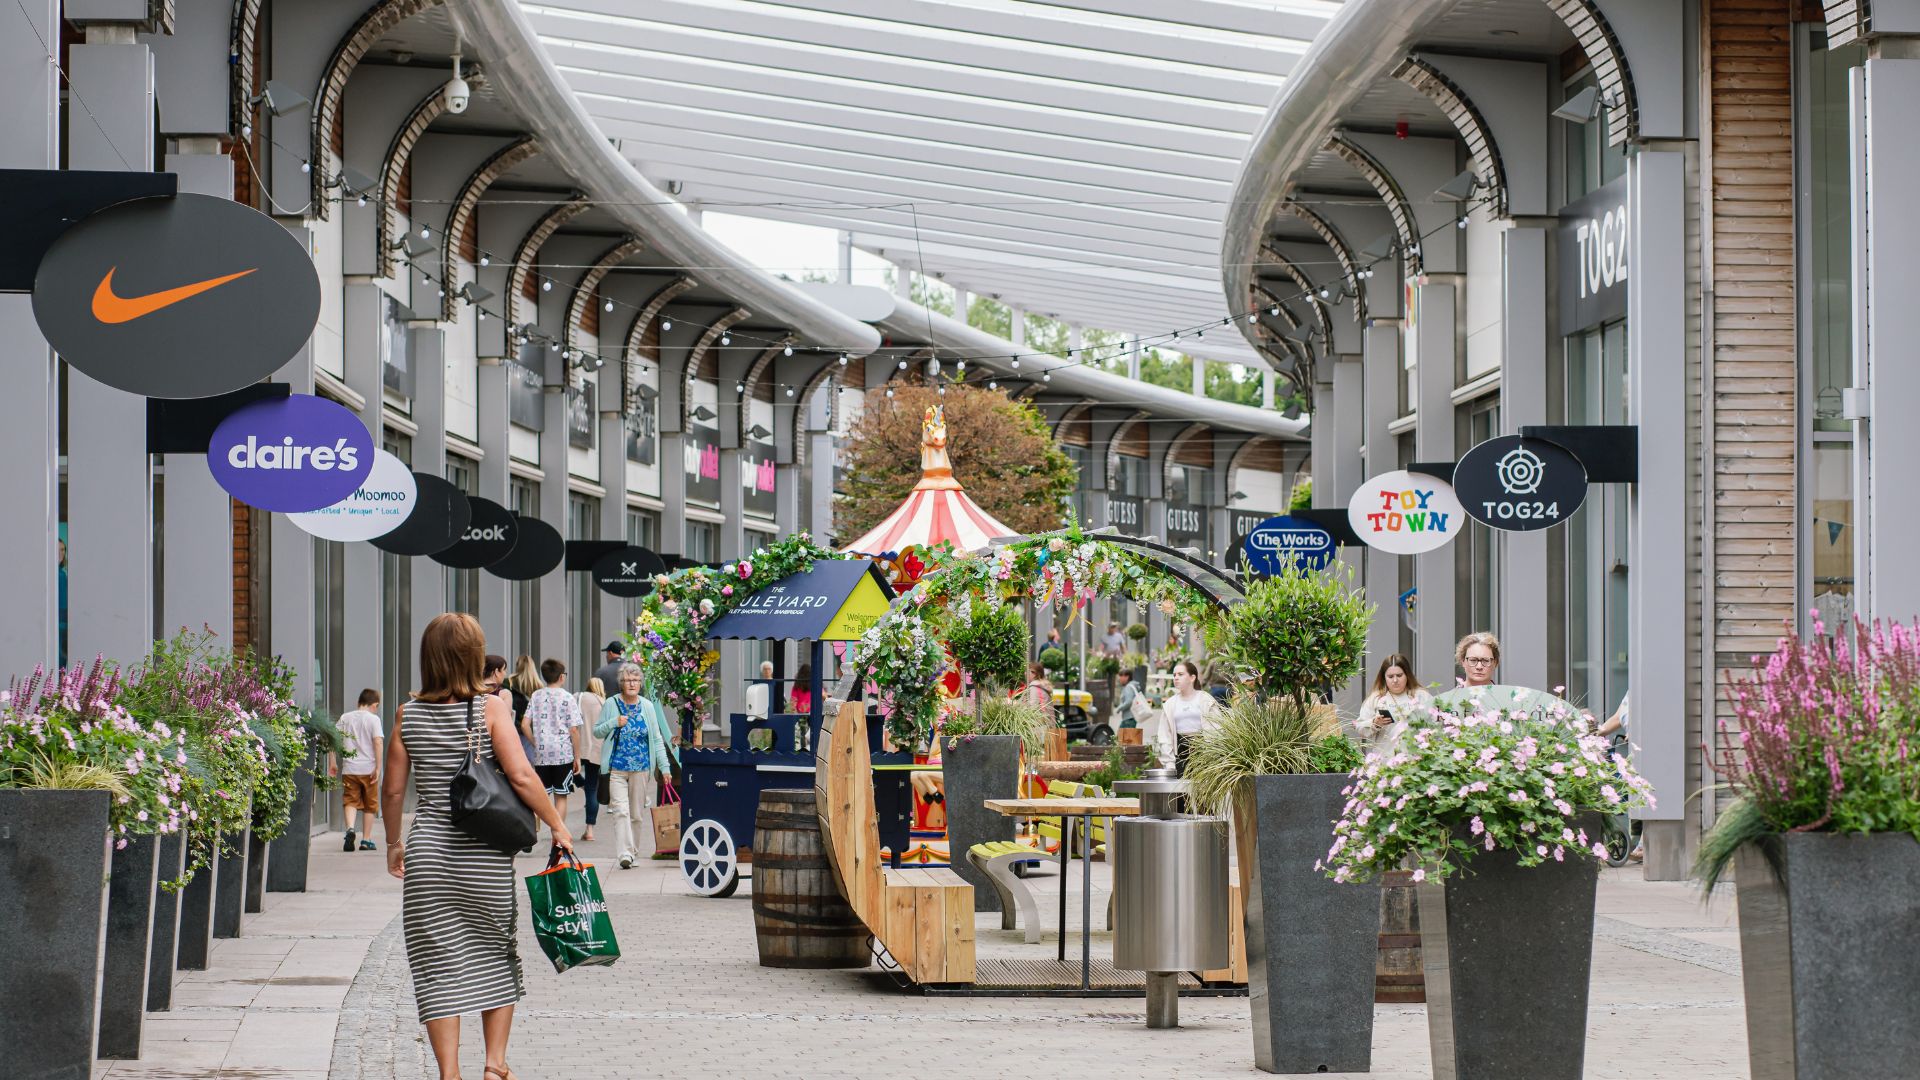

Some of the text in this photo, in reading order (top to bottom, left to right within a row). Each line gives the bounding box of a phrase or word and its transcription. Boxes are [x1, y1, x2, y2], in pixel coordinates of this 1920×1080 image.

[1577, 205, 1628, 299] TOG2
[228, 435, 358, 472] claire's
[354, 488, 406, 502] Moomoo
[1380, 489, 1434, 511] TOY
[348, 507, 373, 517] Unique
[381, 507, 400, 515] Local
[1107, 500, 1137, 525] GUESS
[1167, 508, 1199, 533] GUESS
[1482, 501, 1560, 520] TOG24
[1367, 511, 1449, 533] TOWN
[1257, 533, 1324, 546] The Works
[740, 595, 828, 608] ULEVARD
[843, 624, 856, 634] The
